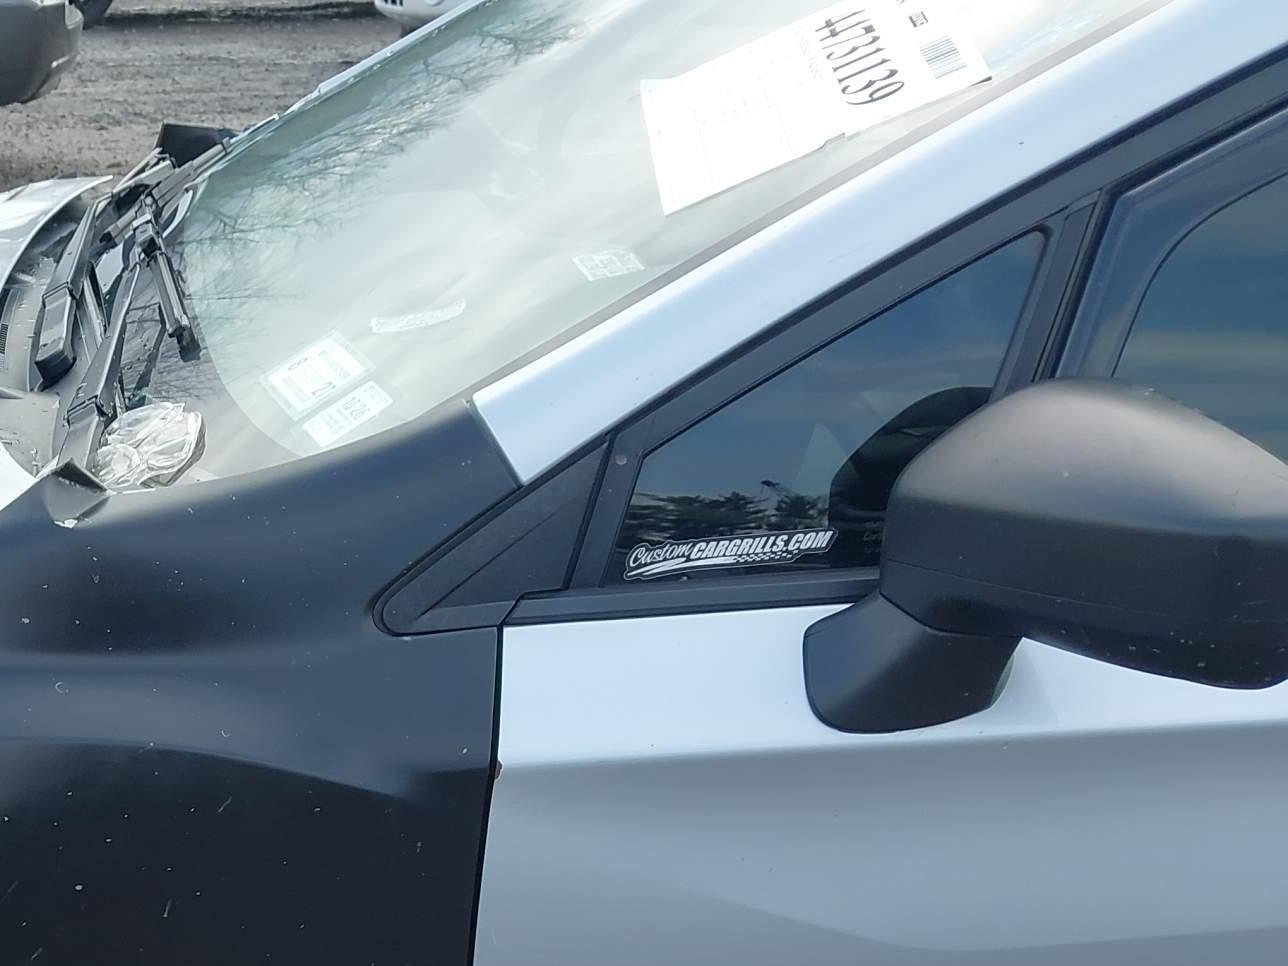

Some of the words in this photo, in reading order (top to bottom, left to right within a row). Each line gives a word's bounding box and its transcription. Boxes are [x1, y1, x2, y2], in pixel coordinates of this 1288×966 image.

[814, 9, 905, 105] 44731139
[629, 541, 692, 568] Custom
[689, 530, 834, 560] CARGRILLS.COM
